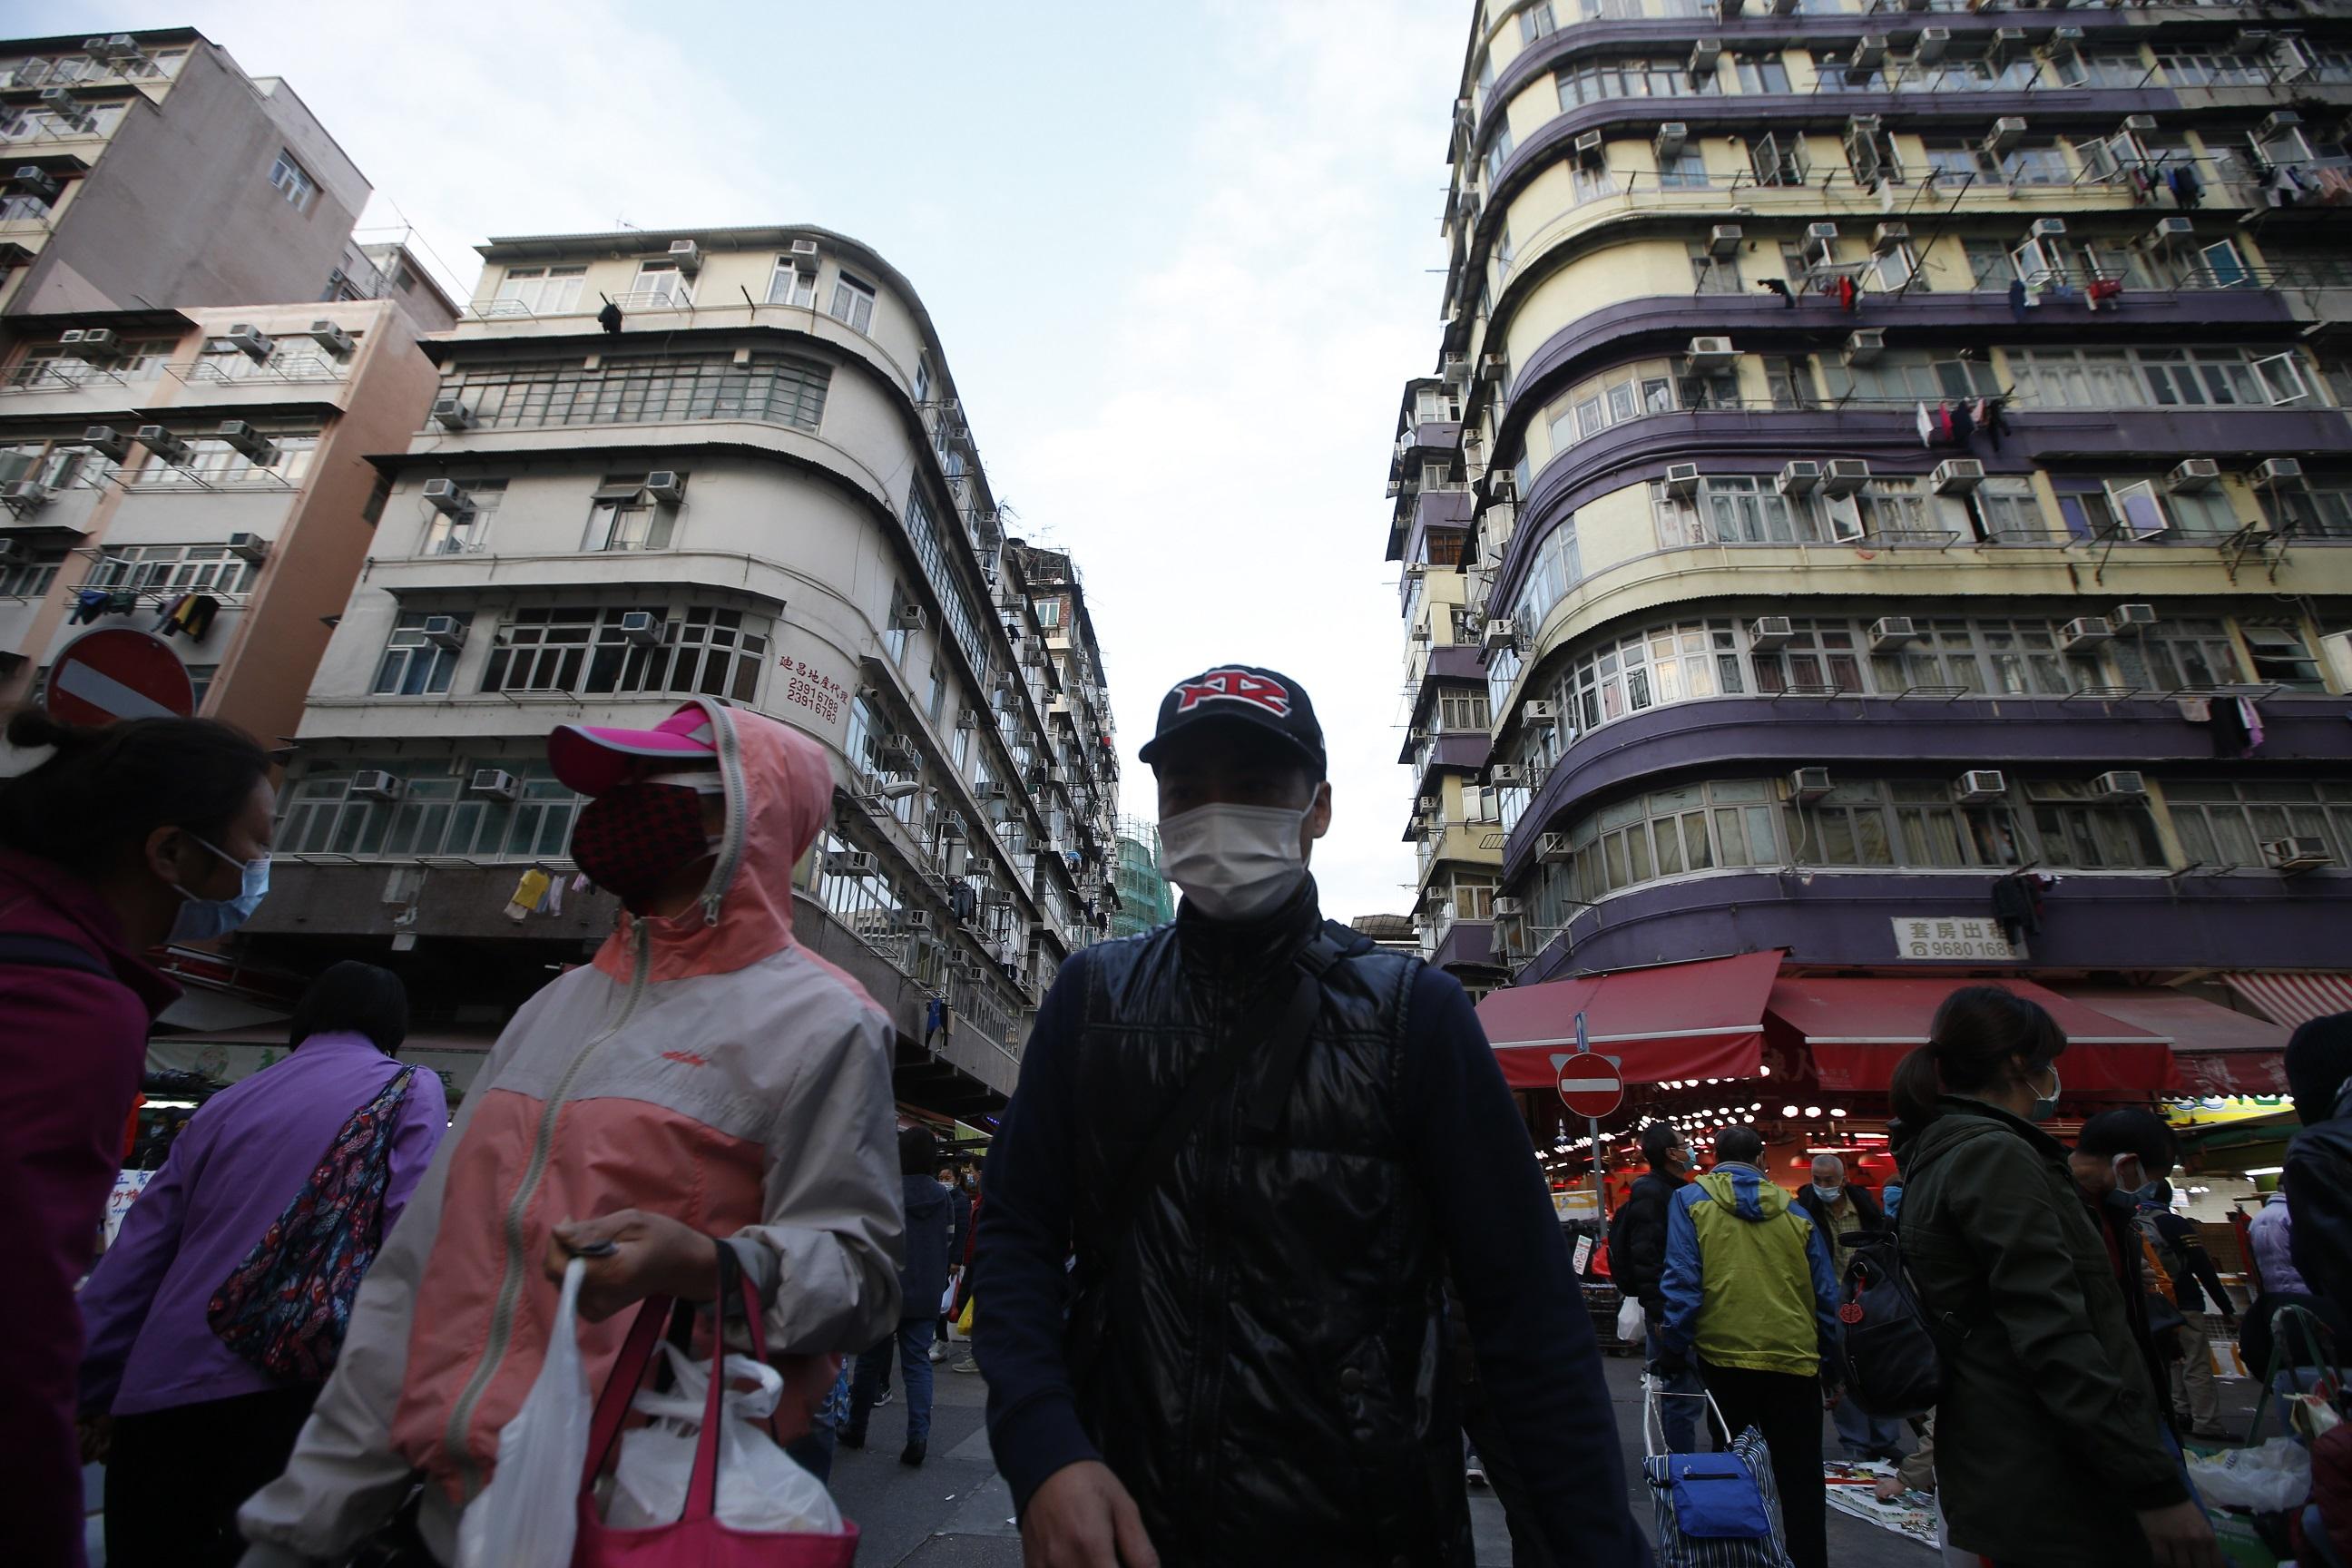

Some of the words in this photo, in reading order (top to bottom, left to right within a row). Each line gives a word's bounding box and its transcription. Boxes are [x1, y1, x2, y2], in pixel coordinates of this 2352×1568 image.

[1909, 922, 2008, 939] 套房出租
[1932, 941, 1974, 956] 9680
